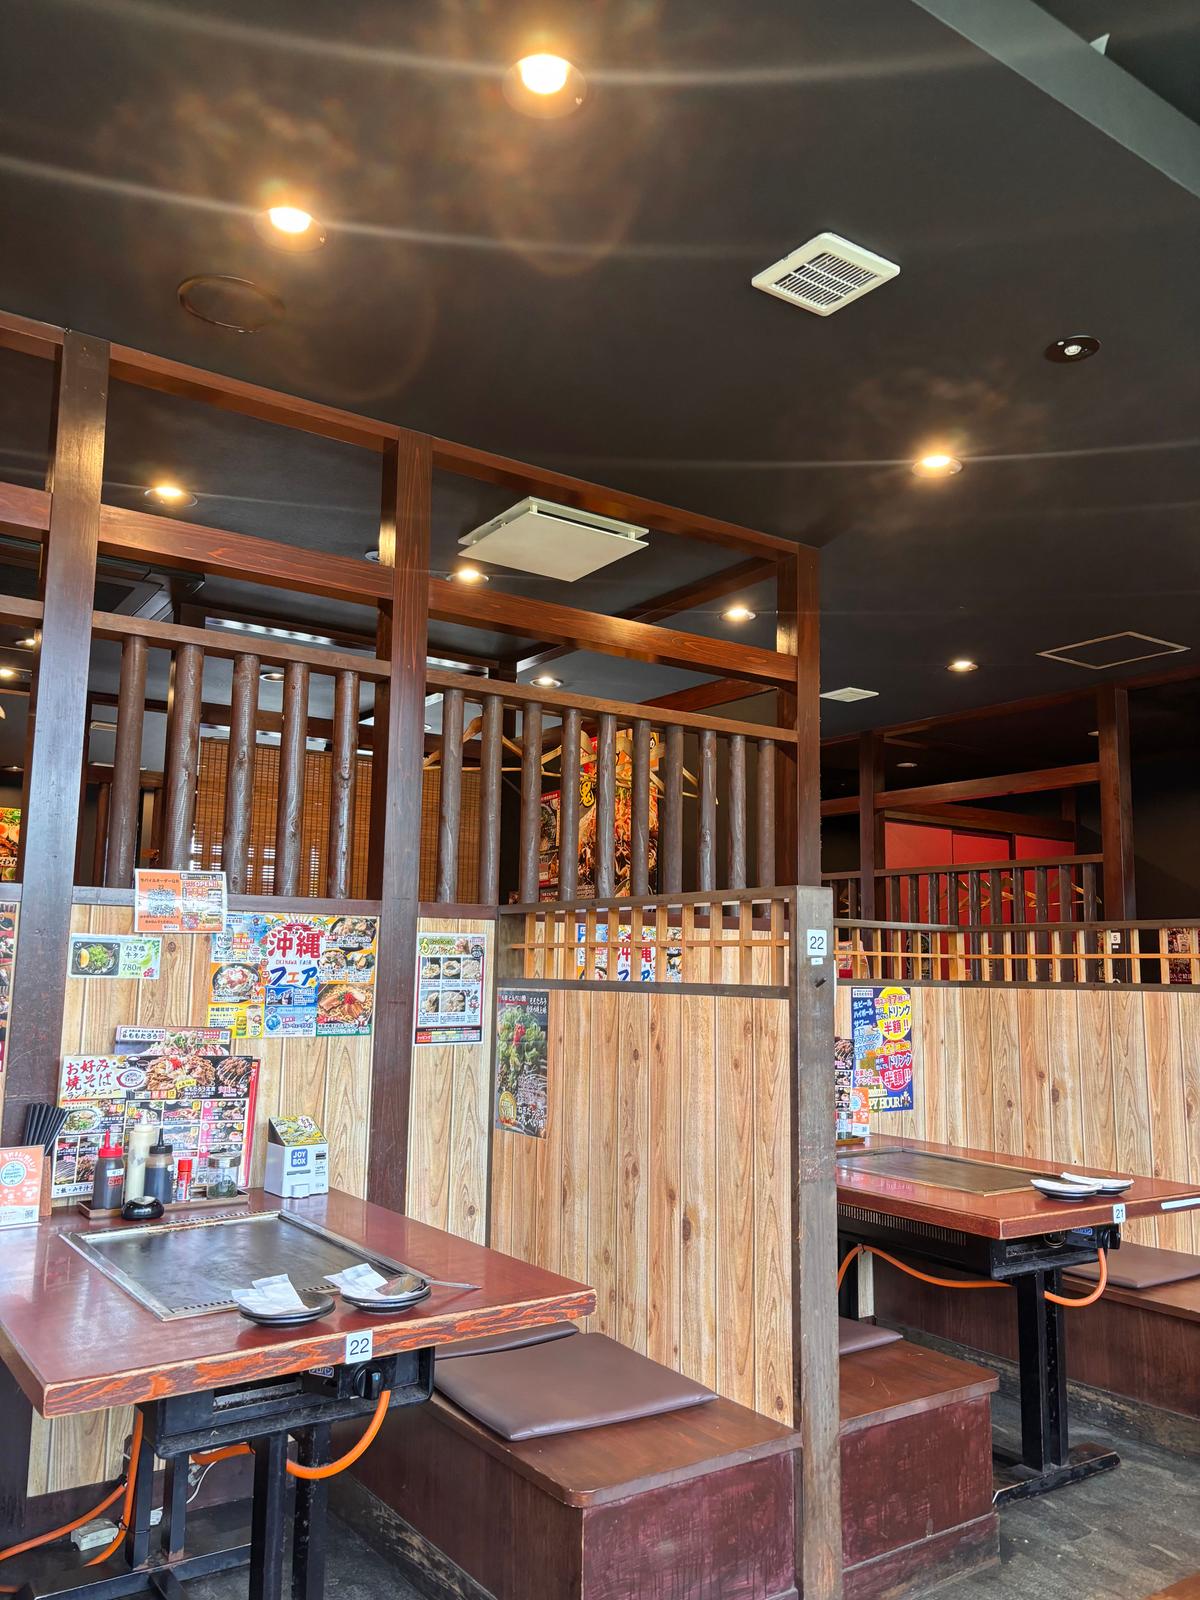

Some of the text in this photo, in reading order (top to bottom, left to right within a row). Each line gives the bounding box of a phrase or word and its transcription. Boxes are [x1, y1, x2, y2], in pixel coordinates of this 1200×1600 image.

[267, 931, 321, 959] 沖縄
[810, 936, 824, 949] 22
[122, 963, 141, 971] 780円
[270, 966, 318, 987] フェア
[853, 999, 873, 1010] 生ビール
[888, 1004, 911, 1018] ドリンク
[853, 1008, 874, 1019] ハイボール
[853, 1019, 870, 1027] サワー
[128, 1032, 158, 1040] ももたろう
[888, 1052, 911, 1068] ドリンク
[66, 1059, 110, 1075] お好み
[65, 1072, 112, 1092] 焼そば
[67, 1088, 121, 1099] ランチメニュー
[1115, 1209, 1124, 1219] 21
[349, 1338, 370, 1356] 22
